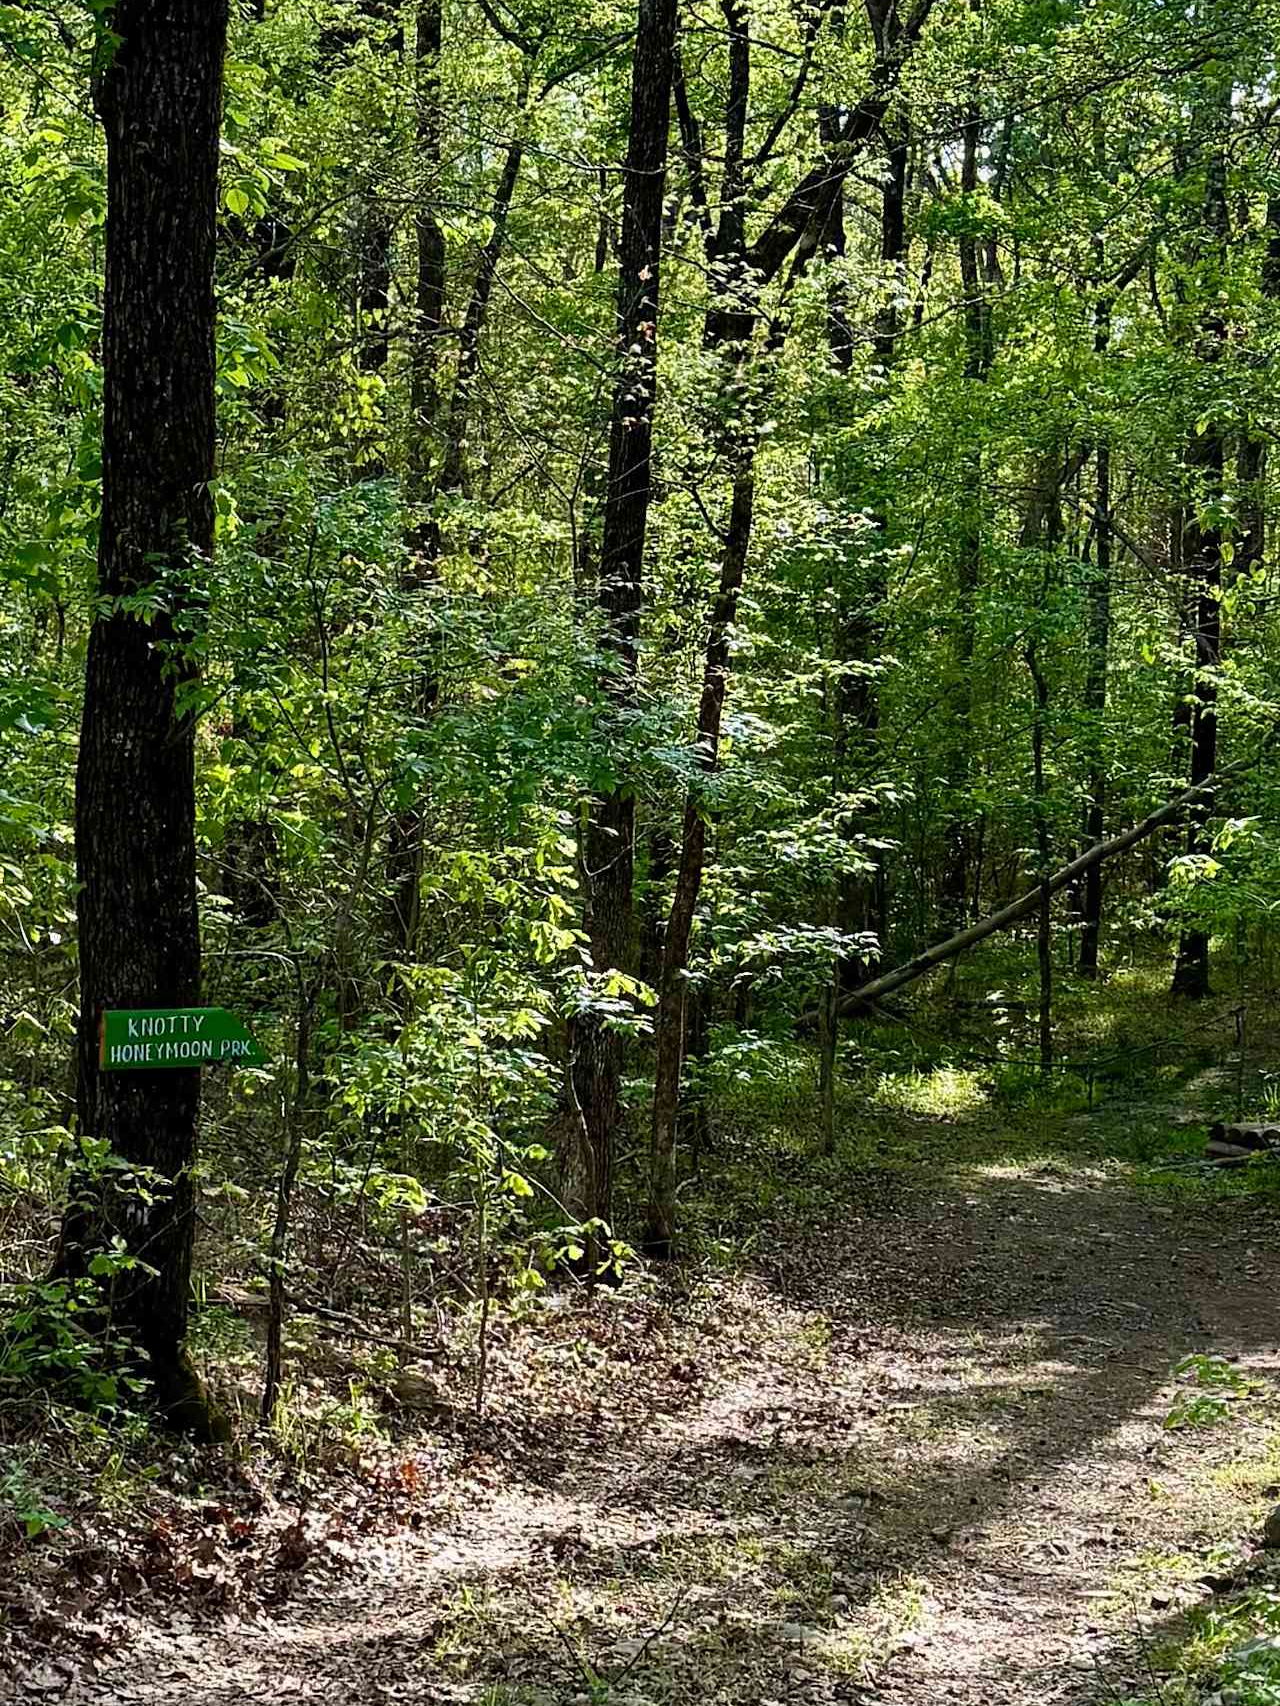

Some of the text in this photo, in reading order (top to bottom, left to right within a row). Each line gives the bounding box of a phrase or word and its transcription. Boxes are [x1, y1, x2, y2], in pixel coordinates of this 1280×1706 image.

[128, 1015, 205, 1037] KNOTTY
[110, 1039, 256, 1063] HONEYMOON PRK.
